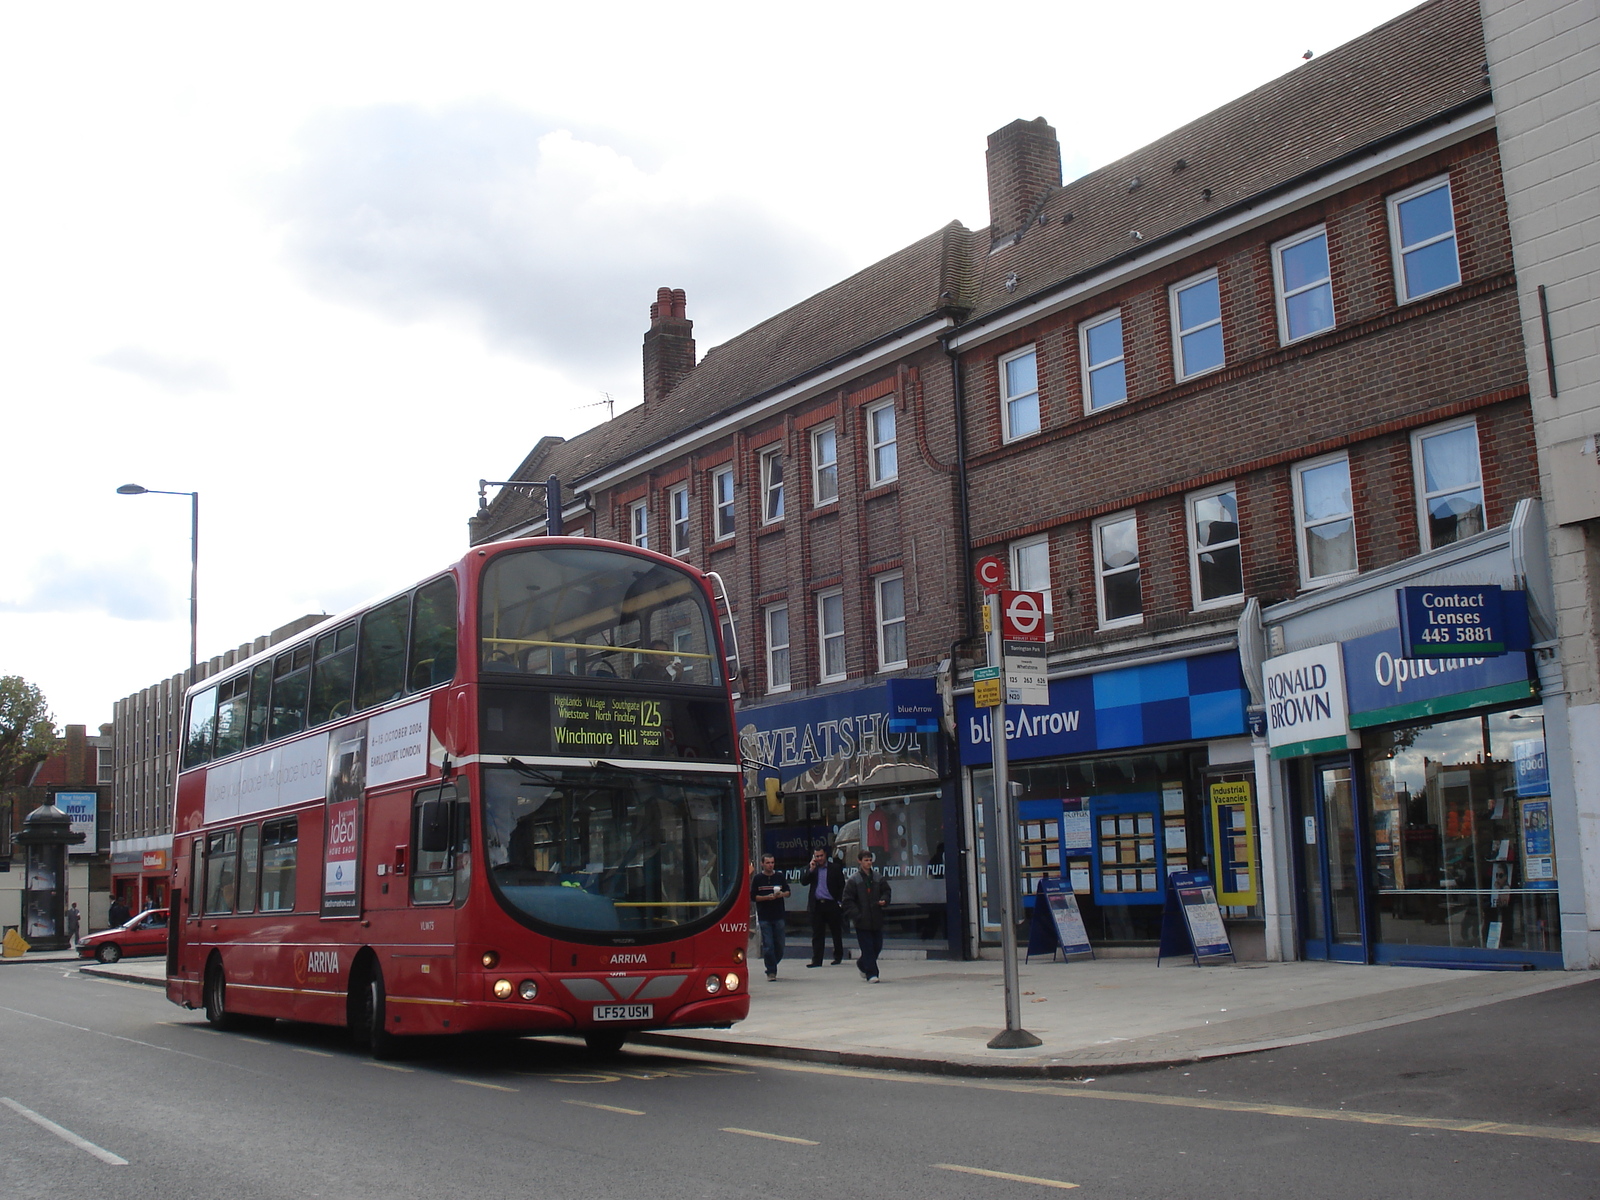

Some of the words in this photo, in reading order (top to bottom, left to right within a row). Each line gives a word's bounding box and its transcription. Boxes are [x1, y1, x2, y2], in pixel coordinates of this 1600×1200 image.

[981, 562, 998, 583] C
[1422, 593, 1484, 608] Contact
[1428, 611, 1480, 625] Lenses
[1422, 628, 1450, 642] 445
[1456, 627, 1492, 642] 5881
[1268, 664, 1327, 700] RONALD
[554, 695, 583, 708] Highlands
[585, 697, 605, 711] Village
[612, 699, 640, 713] Southgate
[1271, 692, 1332, 729] BROWN
[558, 708, 590, 720] Whetstone
[595, 710, 612, 721] North
[614, 711, 637, 725] Finchley
[641, 701, 662, 728] 125
[384, 726, 408, 743] OCTOBER
[409, 722, 423, 736] 2006
[970, 708, 1080, 744] bleArrow
[554, 726, 613, 745] Winchmore
[619, 728, 639, 746] Hill
[643, 738, 659, 746] Road
[370, 754, 384, 767] EARLS
[400, 743, 422, 759] LONDON
[1213, 785, 1245, 795] Industrial
[1213, 794, 1248, 804] Vacancies
[66, 805, 86, 814] MOT
[70, 814, 94, 822] ATION
[785, 869, 801, 880] run
[883, 866, 901, 878] run
[905, 865, 923, 876] run
[926, 864, 946, 879] run
[720, 923, 748, 932] VLW75
[308, 951, 339, 973] ARRIVA
[610, 953, 647, 964] ARRIVA
[597, 1007, 626, 1019] LF52
[628, 1006, 649, 1018] USM
